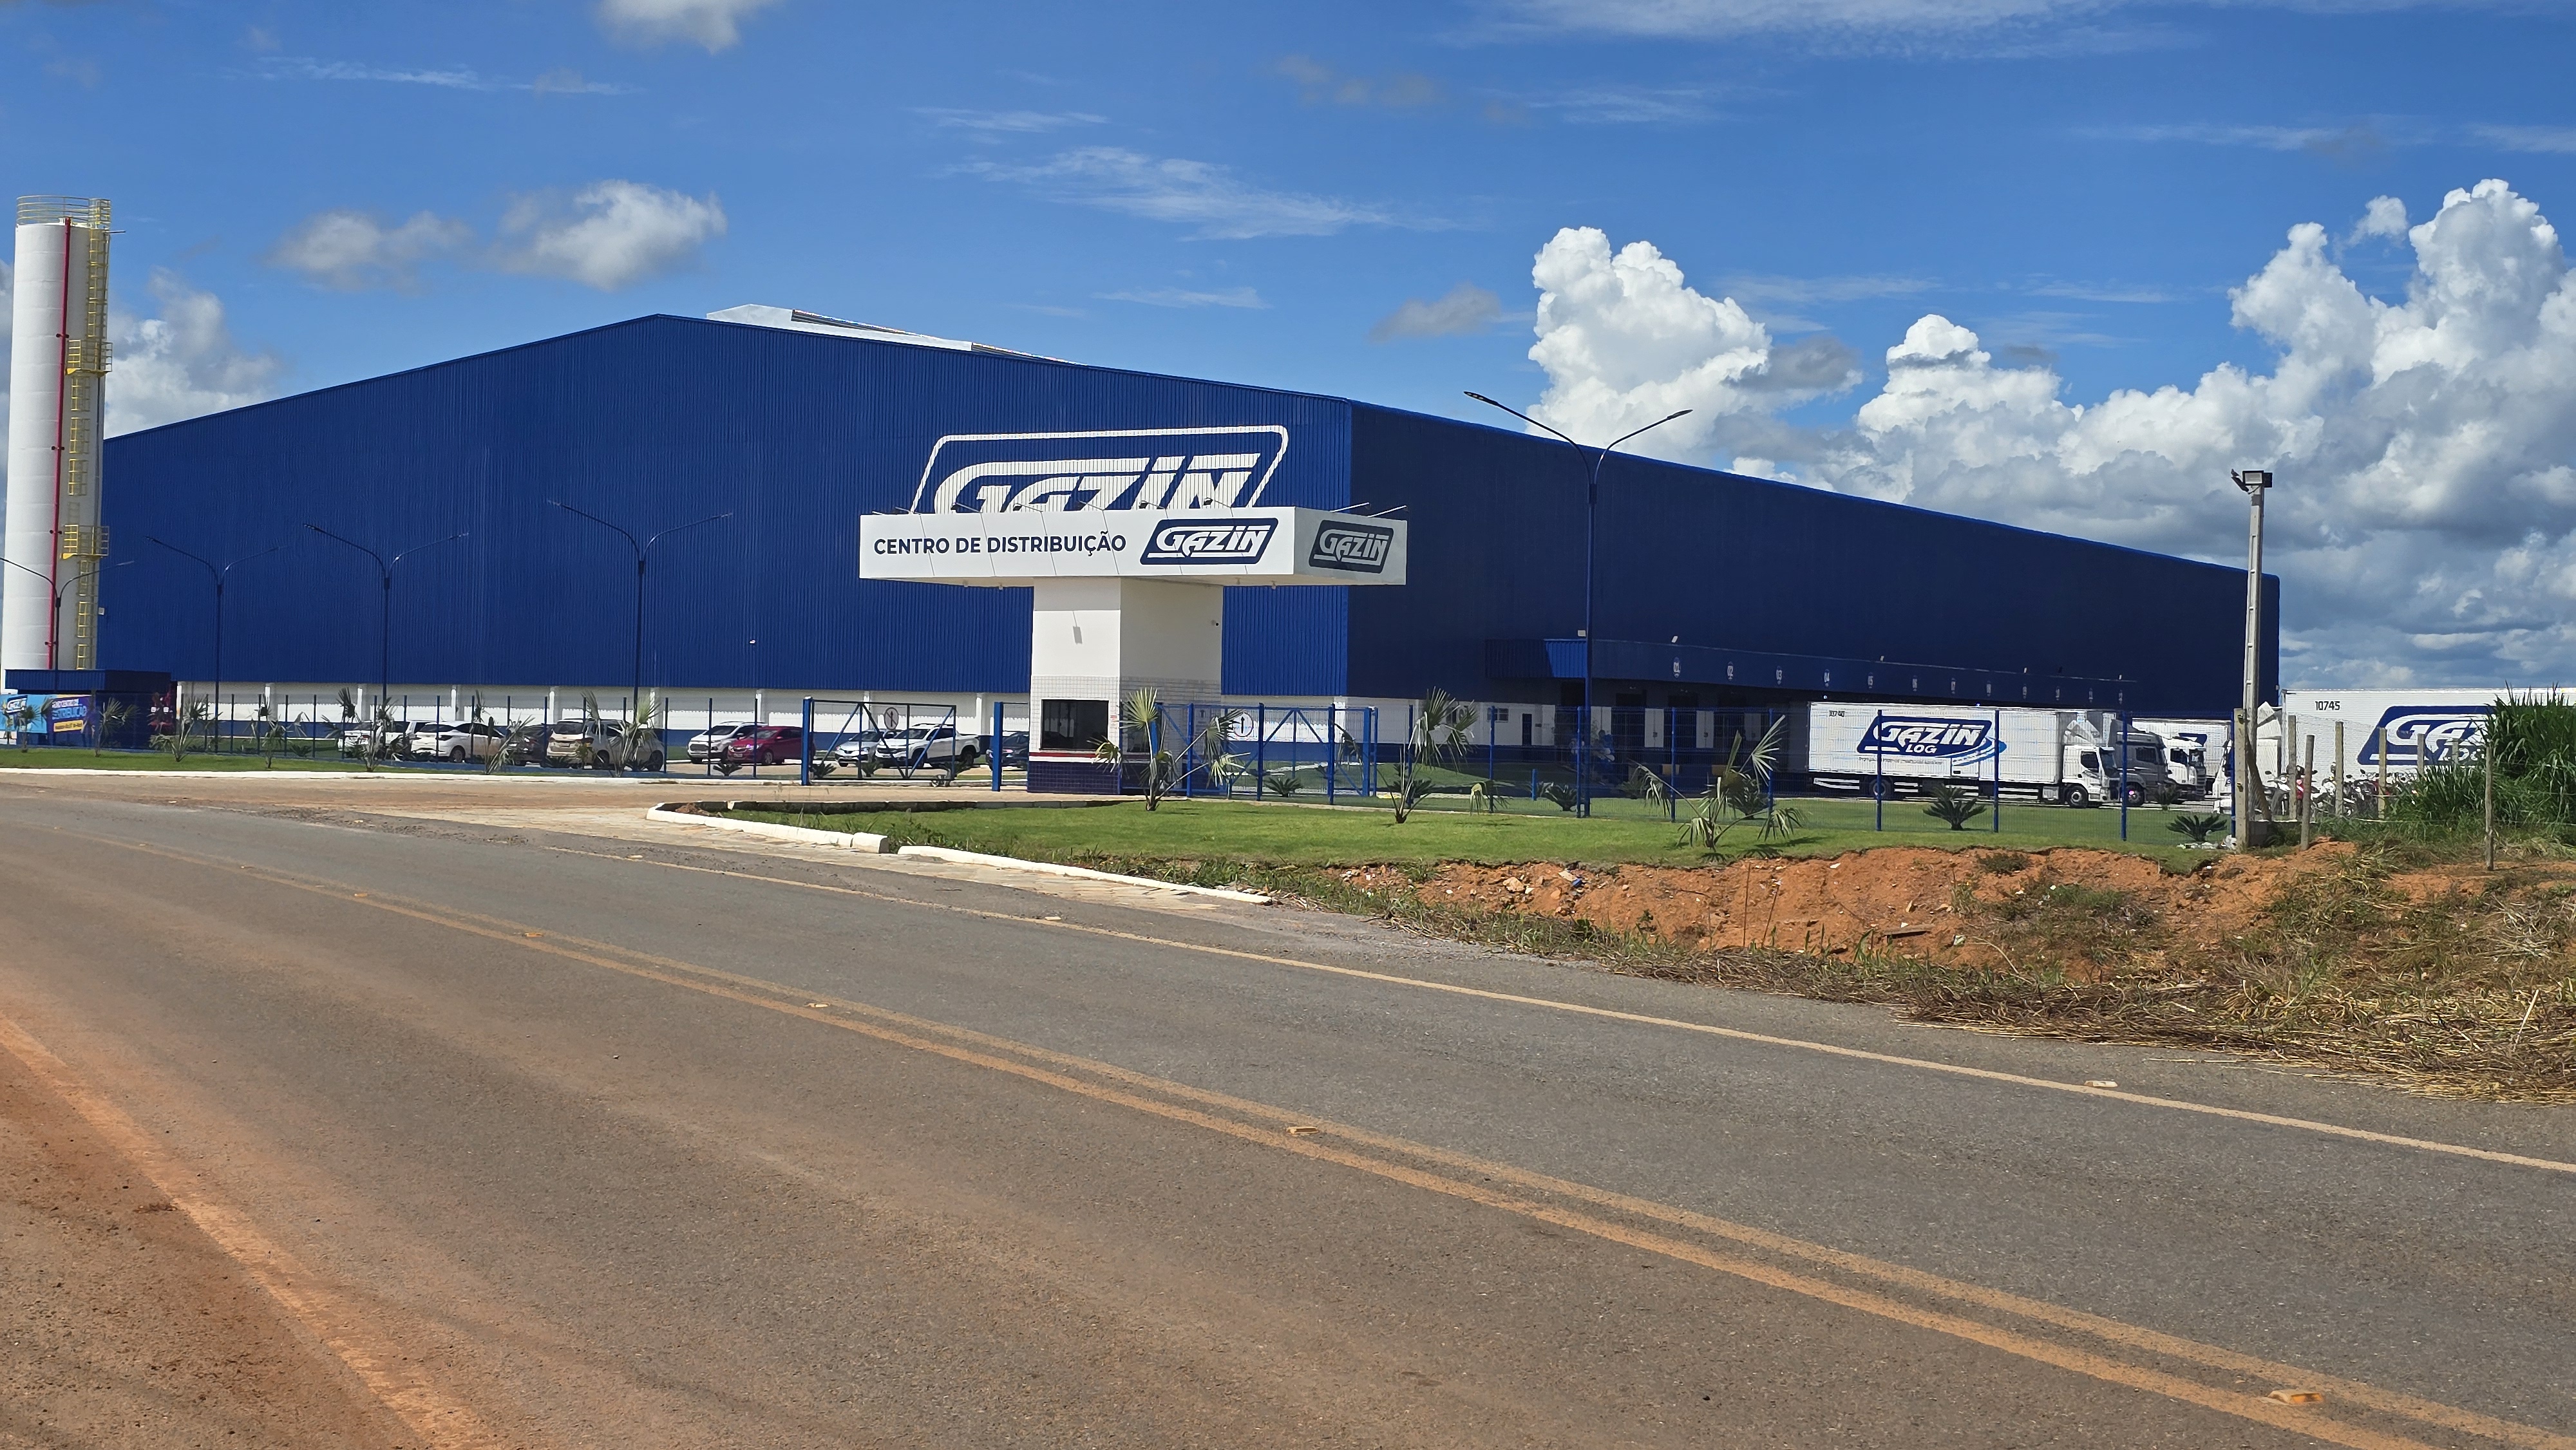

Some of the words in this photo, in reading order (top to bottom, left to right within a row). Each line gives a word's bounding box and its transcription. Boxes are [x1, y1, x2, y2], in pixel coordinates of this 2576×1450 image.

[873, 538, 950, 555] CENTRO
[956, 537, 981, 554] DE
[987, 531, 1126, 557] DISTRIBUIÇÃO
[1155, 525, 1269, 558] GAZIN
[1319, 528, 1389, 567] GAZIN
[2315, 701, 2340, 711] 10745
[1873, 721, 1985, 748] GAZIN
[1905, 744, 1937, 754] LOG
